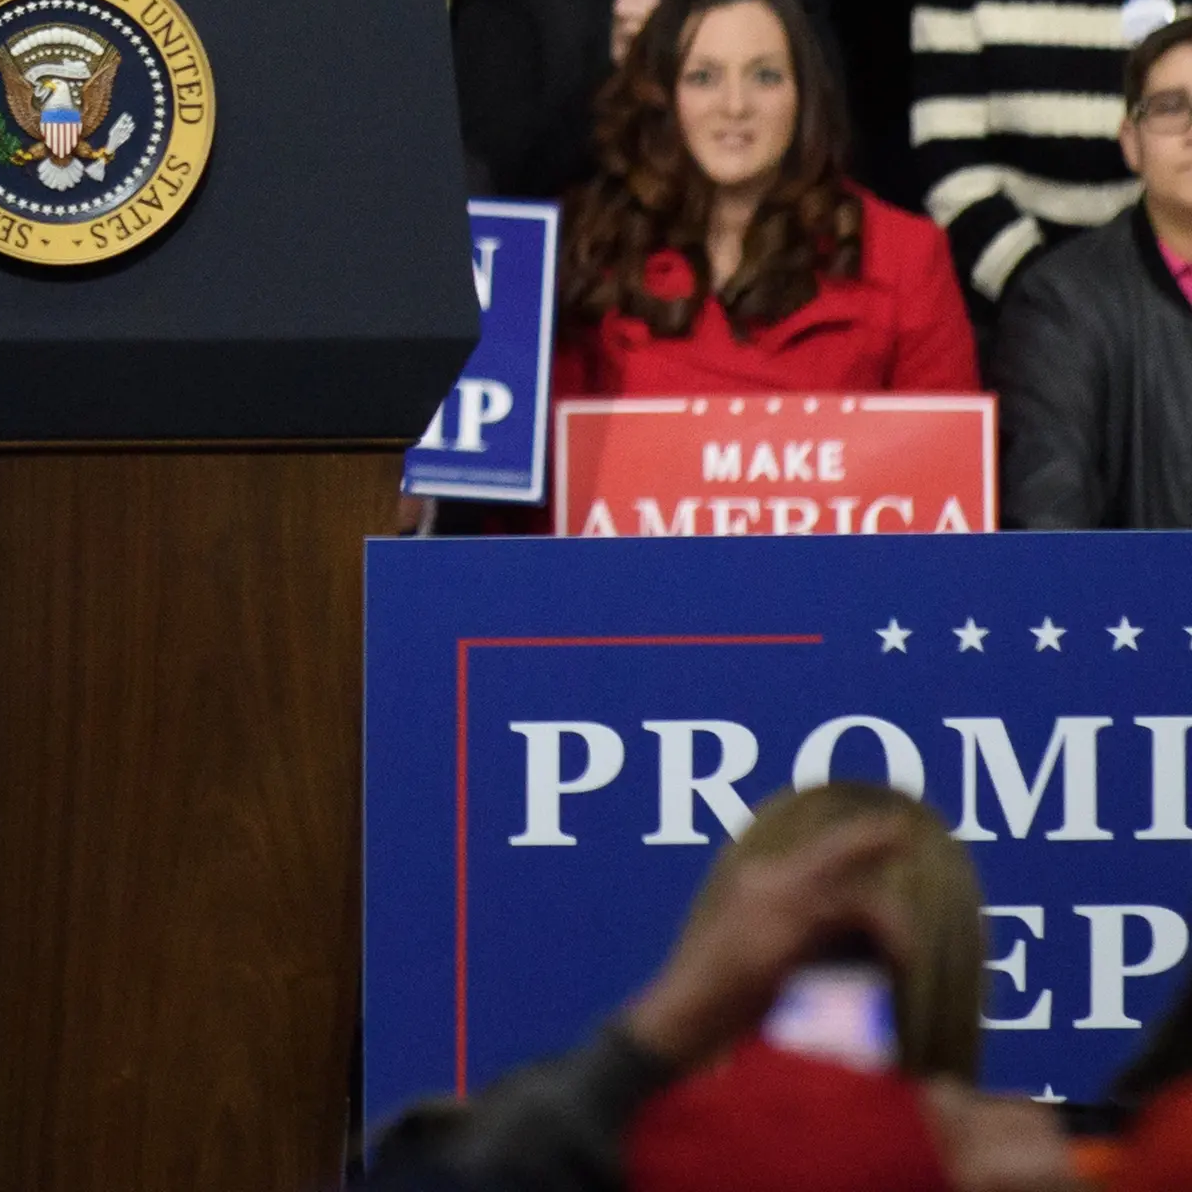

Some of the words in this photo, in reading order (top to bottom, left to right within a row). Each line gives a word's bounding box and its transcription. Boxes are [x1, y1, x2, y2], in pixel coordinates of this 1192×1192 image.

[139, 0, 204, 125] UNITED
[90, 155, 192, 250] STATES
[701, 439, 847, 483] MAKE
[580, 495, 973, 536] AMERICA
[977, 904, 1190, 1030] EP
